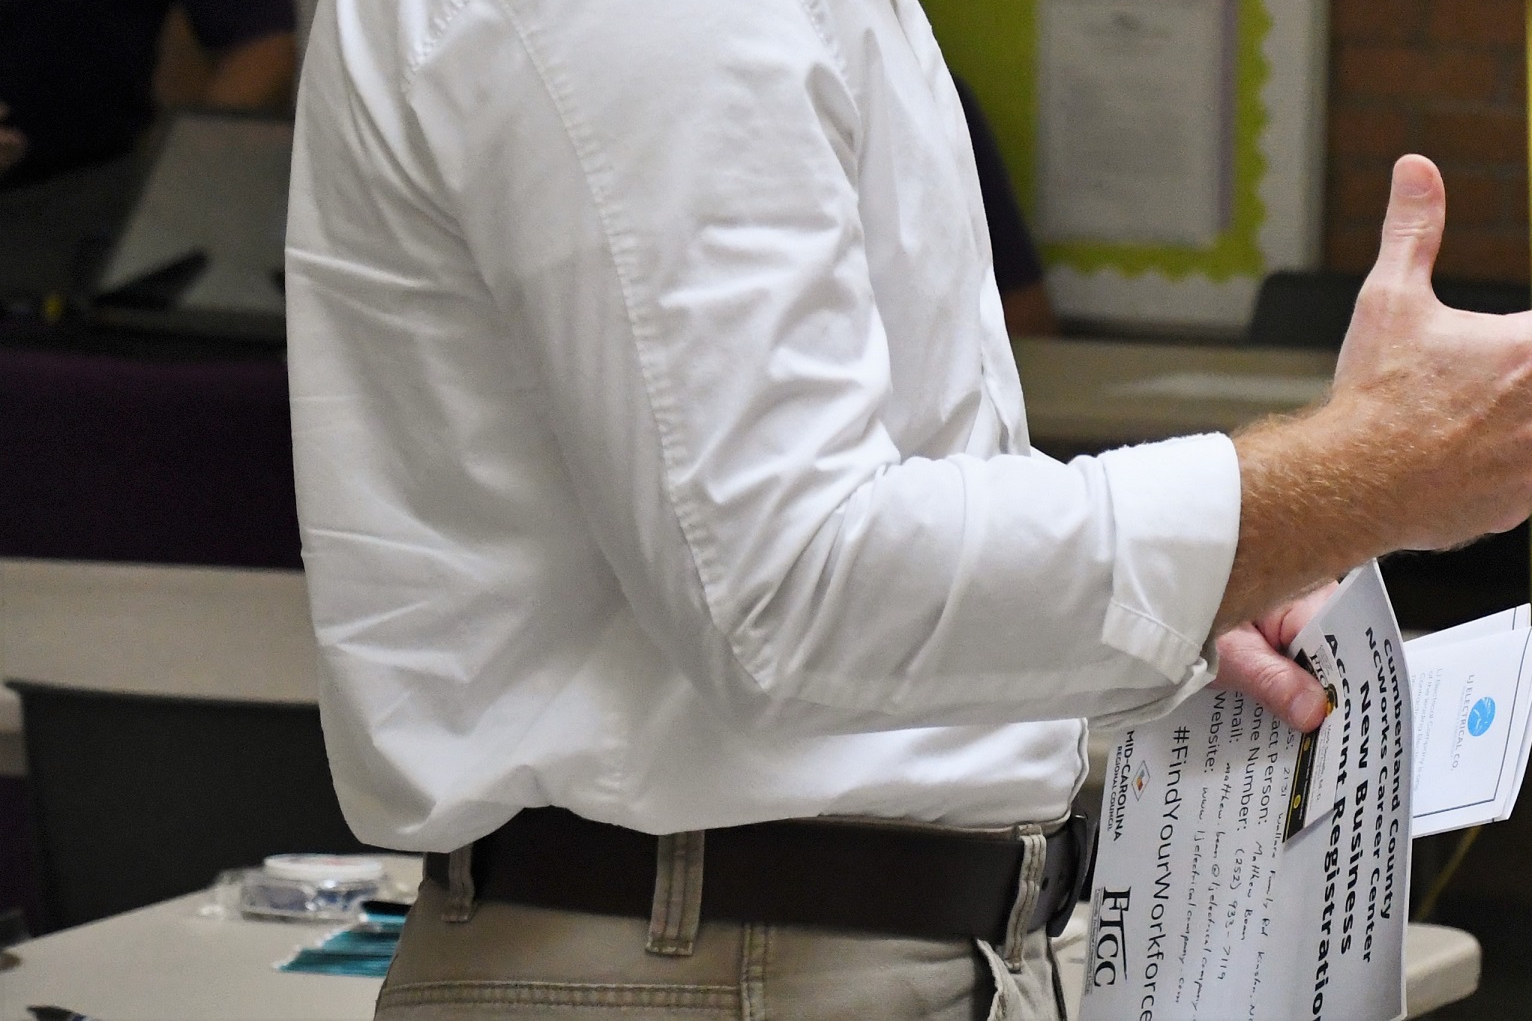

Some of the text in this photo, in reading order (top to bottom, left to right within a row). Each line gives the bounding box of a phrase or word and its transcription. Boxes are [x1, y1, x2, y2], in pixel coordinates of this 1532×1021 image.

[1455, 687, 1473, 752] ELECTRICAL
[1466, 674, 1475, 684] LJ
[1204, 691, 1226, 773] Website:
[1236, 702, 1264, 831] one Number:
[1381, 638, 1403, 919] Cumberland County
[1451, 754, 1460, 771] CO.
[1107, 746, 1122, 831] REGIONAL COUNCIL
[1113, 730, 1135, 841] MID-CAROLINA
[1257, 752, 1278, 825] Person:
[1341, 680, 1371, 955] New Business
[1363, 627, 1390, 963] NCWorks Career Center
[1140, 726, 1190, 1021] #FindYourWorkforce
[1247, 840, 1263, 898] Matthew
[1094, 886, 1131, 987] FTCC
